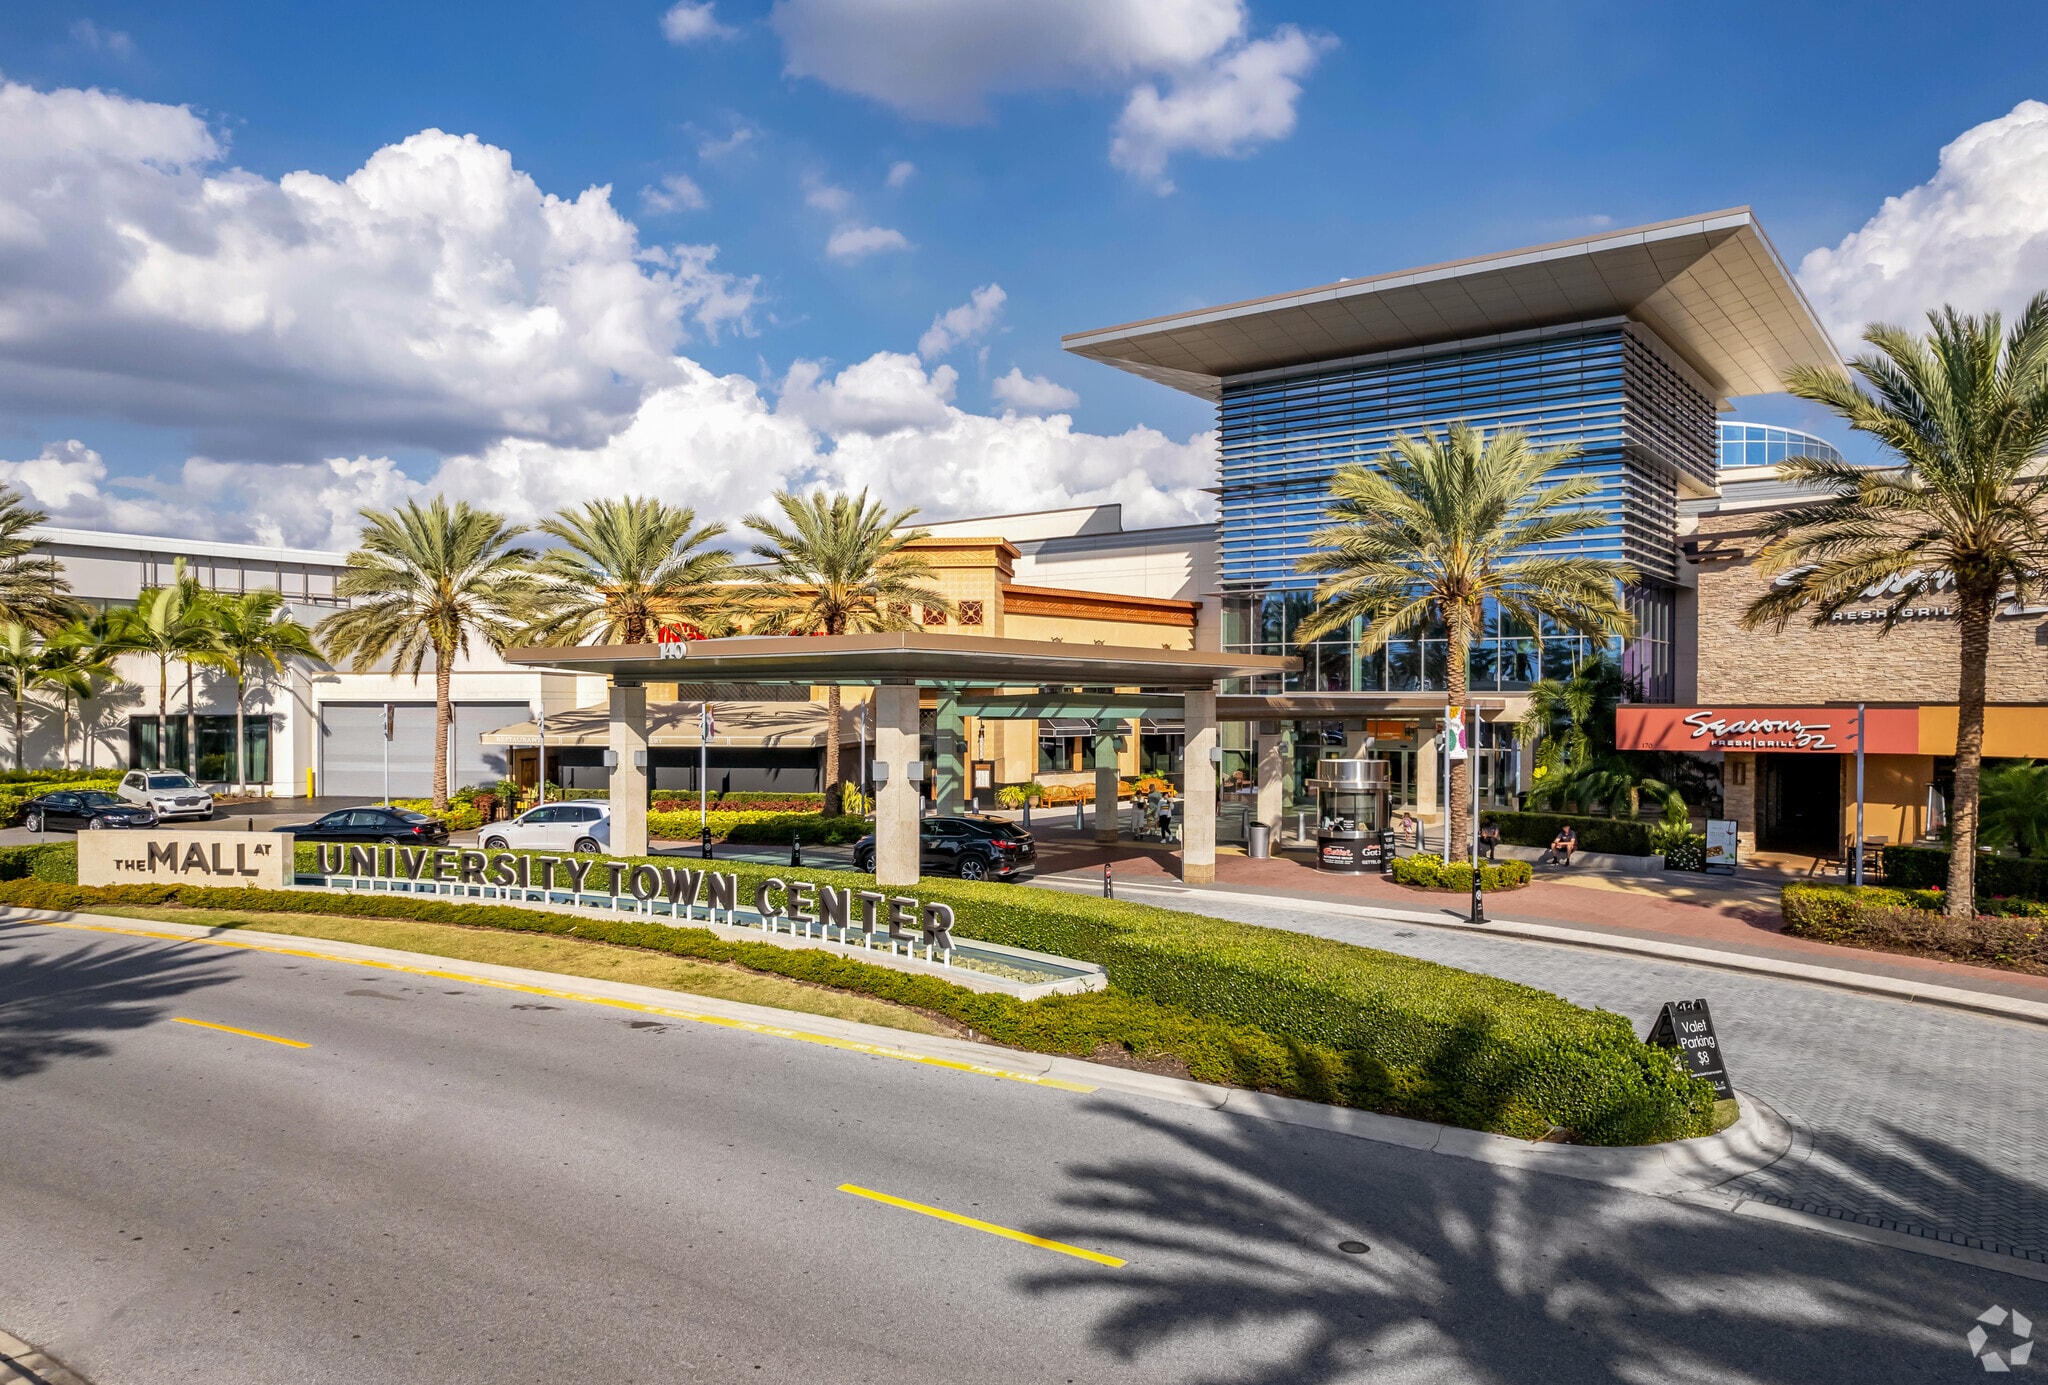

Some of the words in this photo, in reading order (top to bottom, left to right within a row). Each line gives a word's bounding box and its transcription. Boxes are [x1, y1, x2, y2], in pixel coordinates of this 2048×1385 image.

[1832, 609, 1888, 621] RESH
[1901, 606, 1953, 618] GRIL
[658, 642, 688, 660] 140
[1683, 711, 1803, 738] Seasons
[1795, 724, 1837, 750] 52
[496, 736, 541, 744] RESTAURANT
[1641, 742, 1654, 750] 170
[113, 858, 147, 873] THE
[147, 841, 260, 877] MALL
[253, 843, 273, 857] AT
[315, 843, 594, 894] UNIVERSITY
[602, 861, 738, 912] TOWN
[755, 877, 957, 951] CENTER
[1681, 1019, 1708, 1034] Valet
[1680, 1034, 1716, 1051] Parking
[1697, 1050, 1710, 1066] $8
